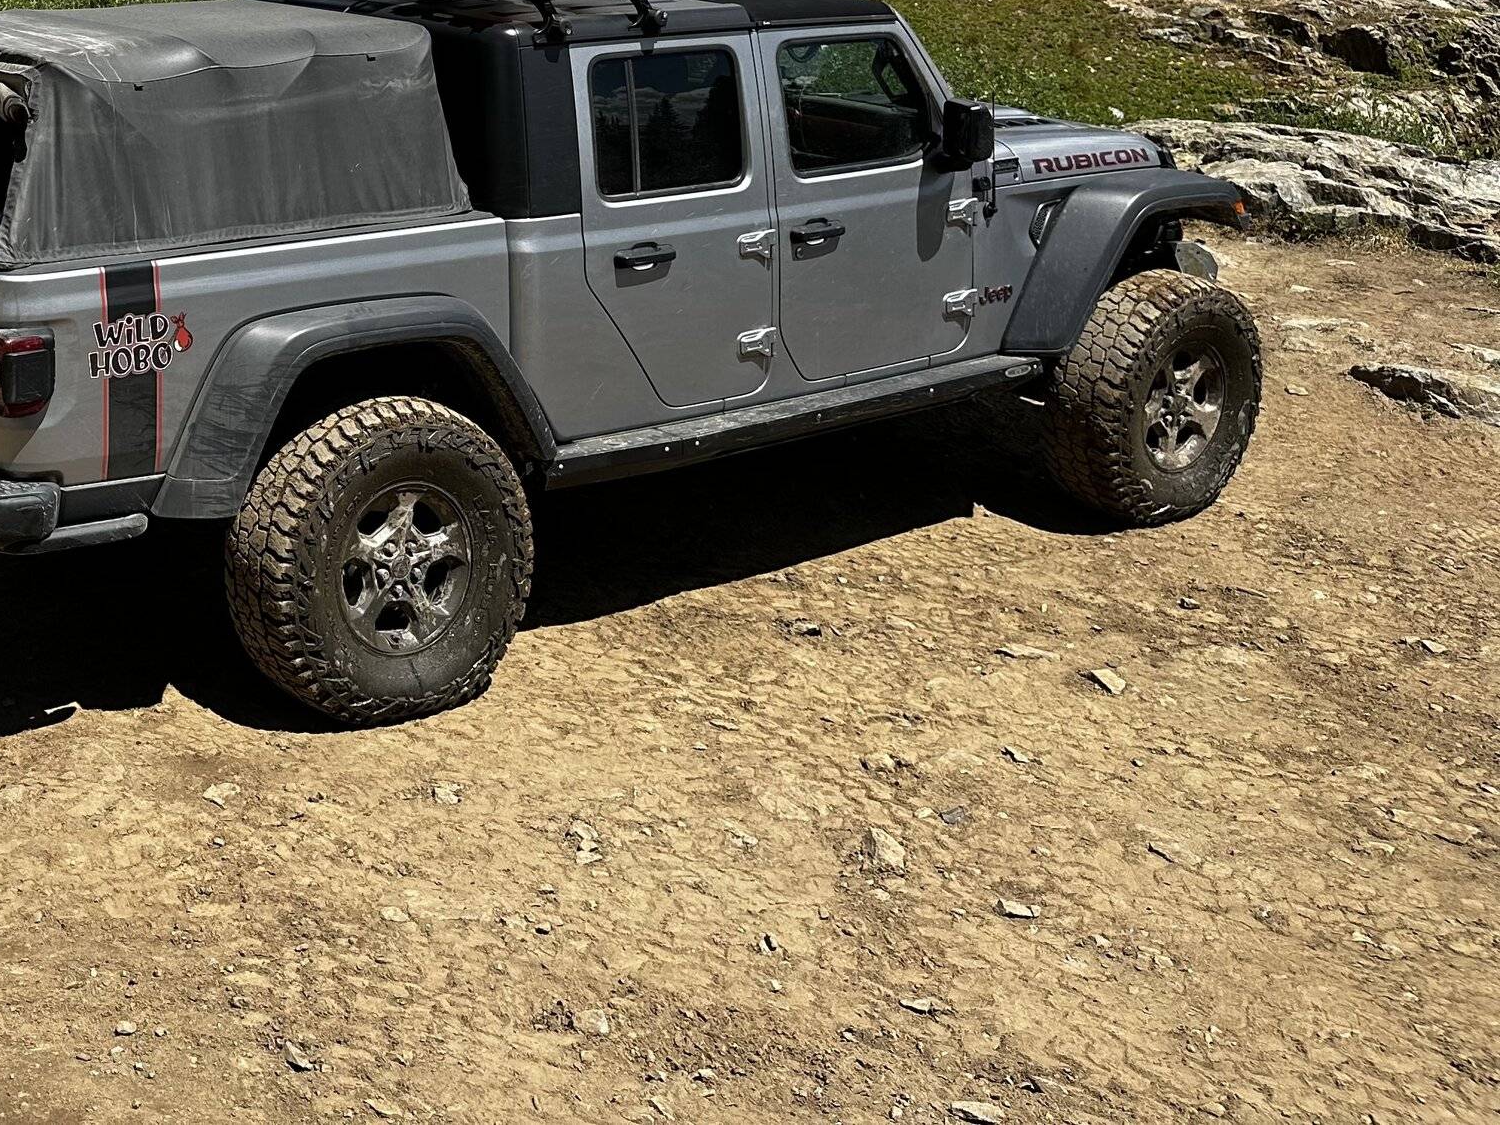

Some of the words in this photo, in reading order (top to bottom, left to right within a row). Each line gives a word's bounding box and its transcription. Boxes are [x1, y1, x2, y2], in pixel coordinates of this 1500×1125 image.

[1032, 148, 1150, 174] RUBICON
[979, 285, 1013, 305] Jeep
[88, 342, 173, 378] HOBO
